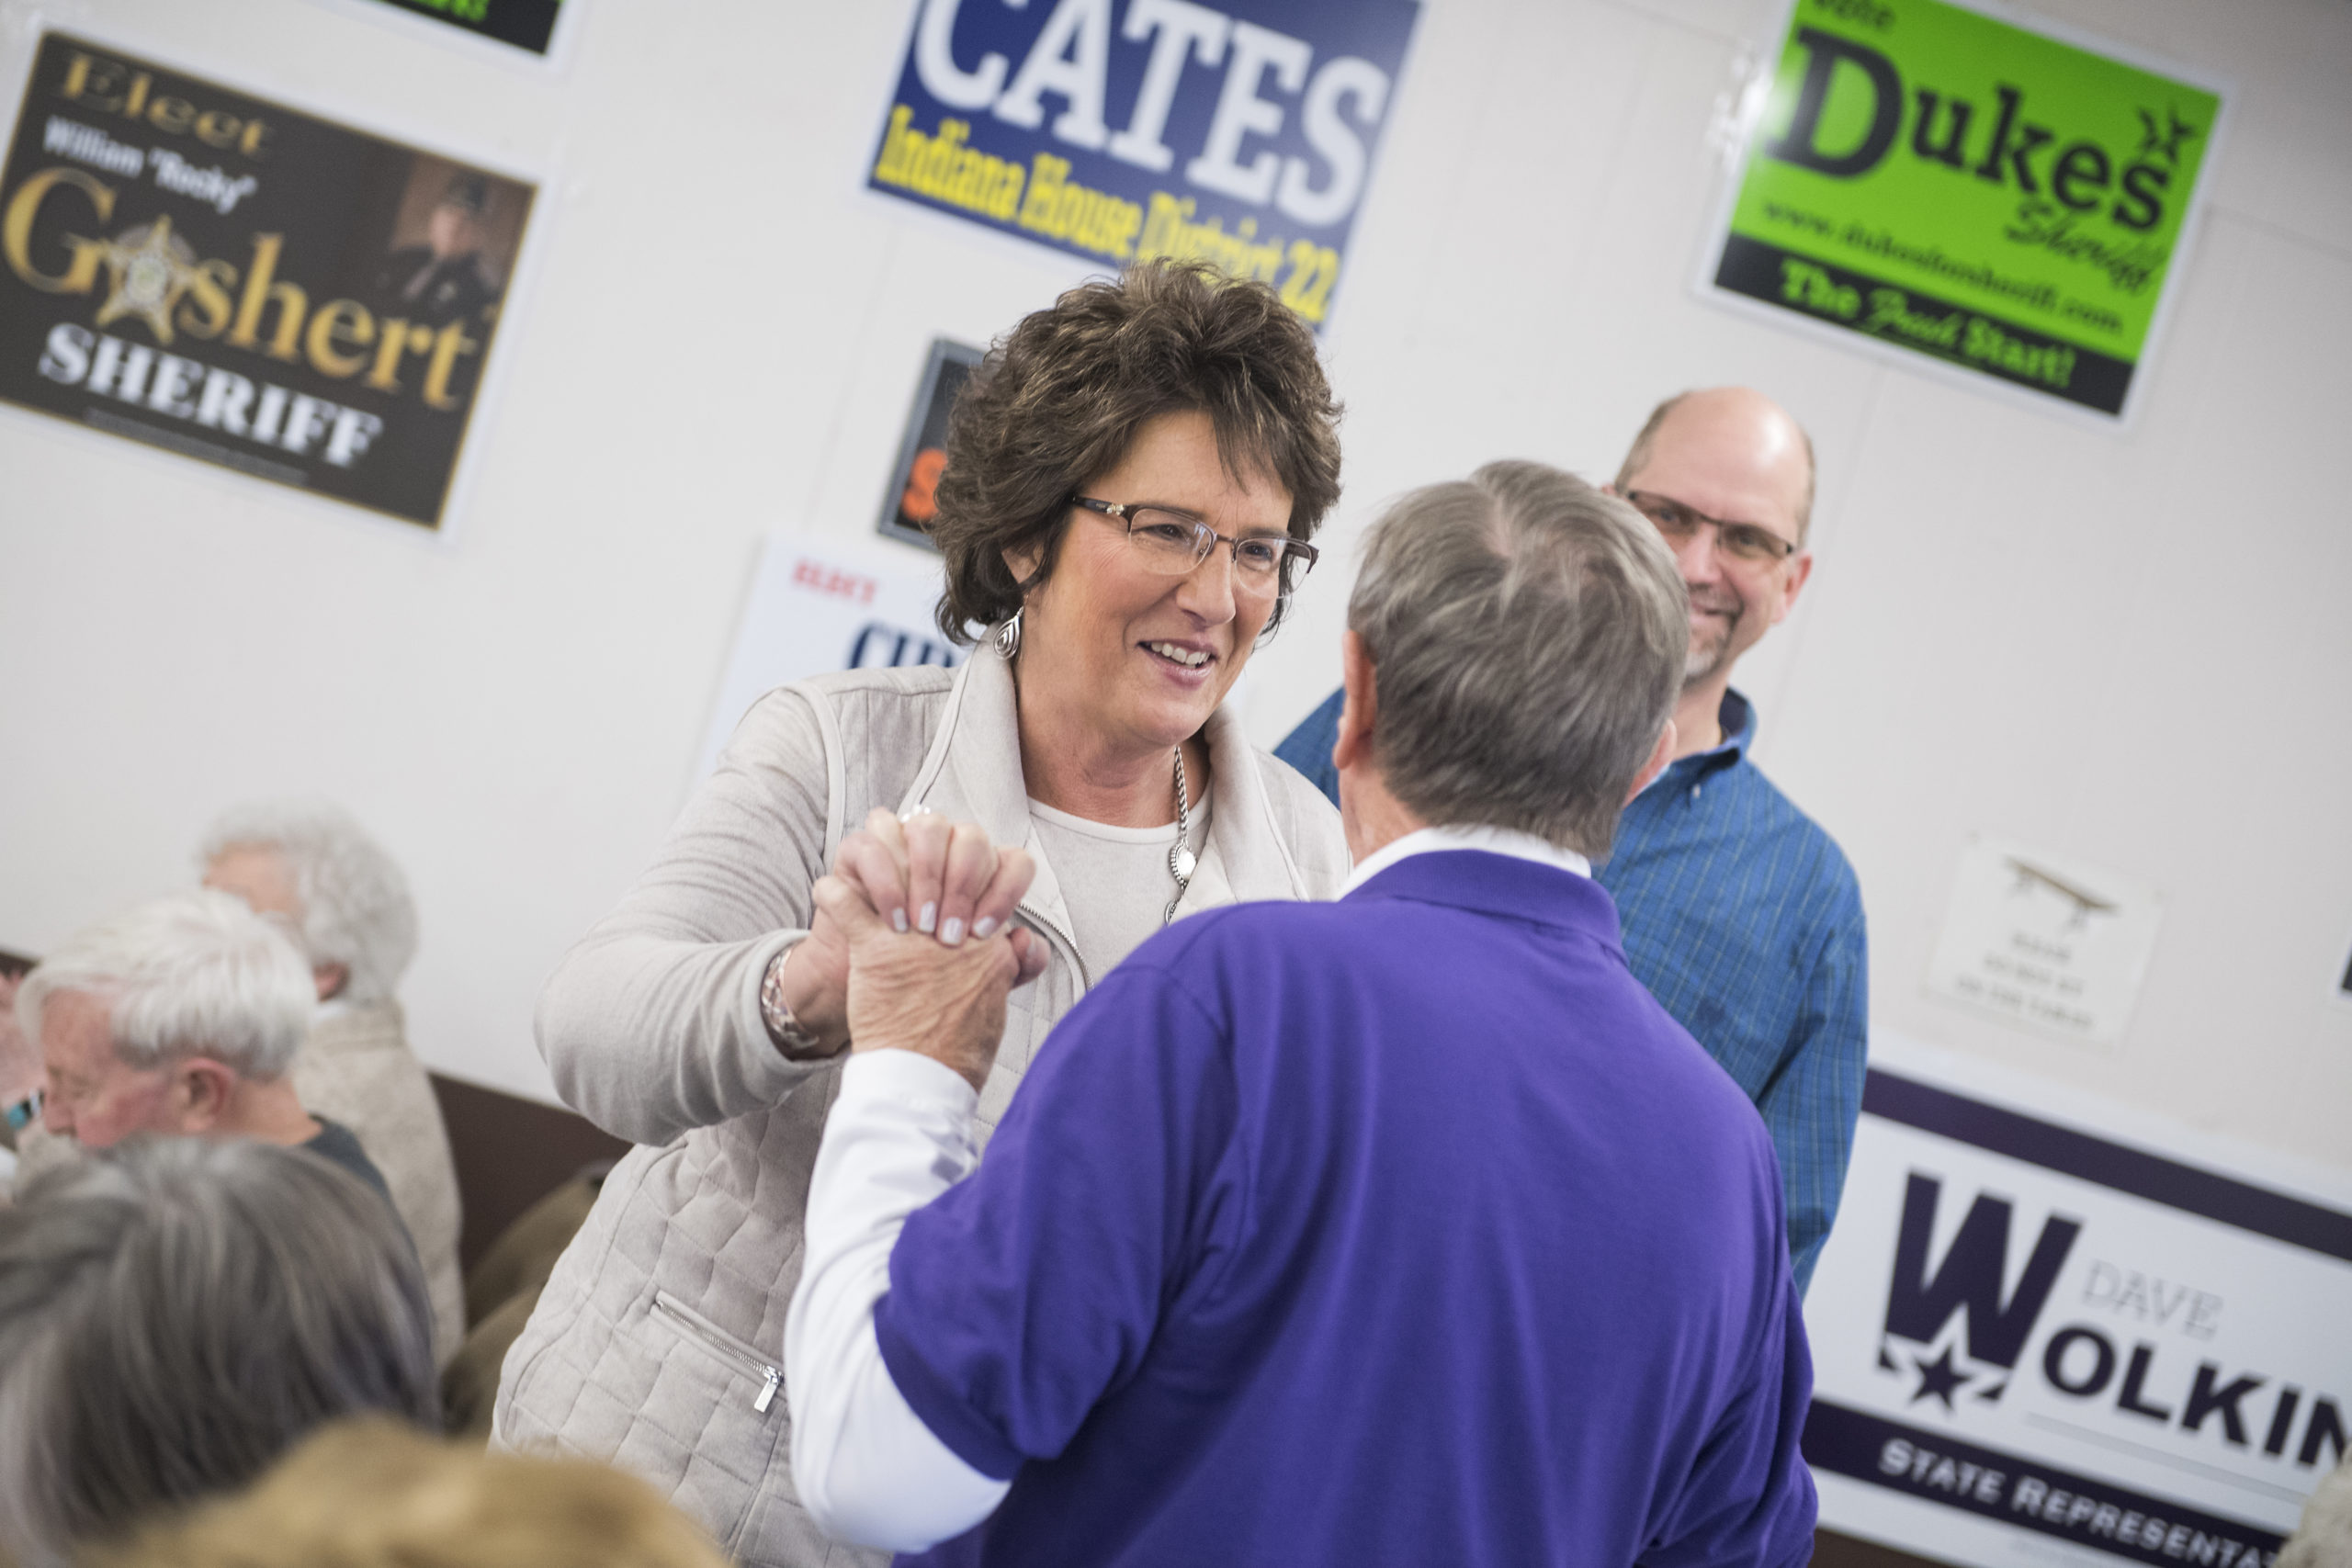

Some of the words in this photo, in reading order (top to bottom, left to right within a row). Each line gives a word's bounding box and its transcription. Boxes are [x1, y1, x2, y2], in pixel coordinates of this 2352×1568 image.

[61, 51, 266, 160] Elect
[914, 0, 1392, 227] CATES
[1764, 25, 2171, 231] Dukes
[876, 104, 1026, 221] Indiana
[1018, 152, 1144, 258] House
[1280, 238, 1340, 323] 22
[3, 166, 478, 409] Gshert
[1781, 255, 1861, 320] The
[38, 321, 383, 467] SHERIFF
[2082, 1259, 2223, 1338] DAVE
[1877, 1438, 2007, 1505] STATE
